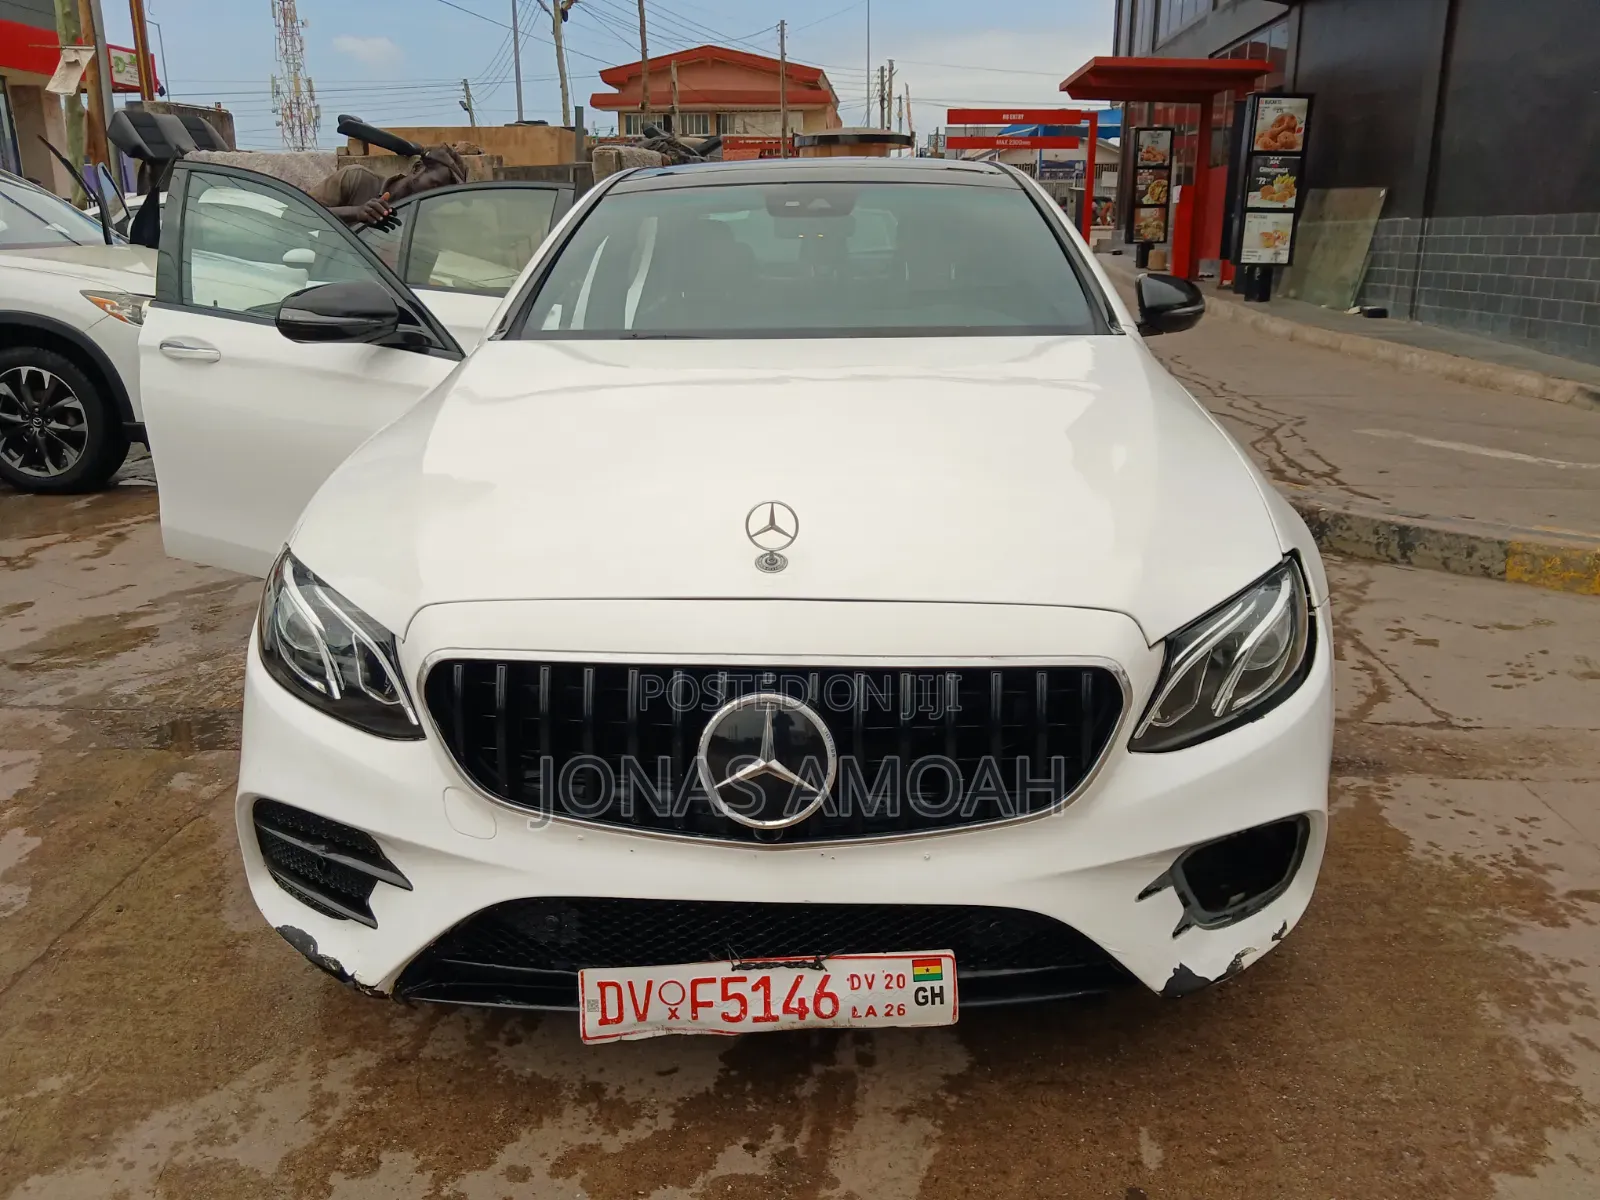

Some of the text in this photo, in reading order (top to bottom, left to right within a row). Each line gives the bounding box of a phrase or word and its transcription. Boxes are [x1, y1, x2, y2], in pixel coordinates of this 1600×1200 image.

[850, 973, 906, 991] DV 20
[596, 979, 654, 1026] DV
[690, 974, 840, 1023] F5146
[914, 985, 944, 1007] GH
[851, 1004, 906, 1018] LA 26
